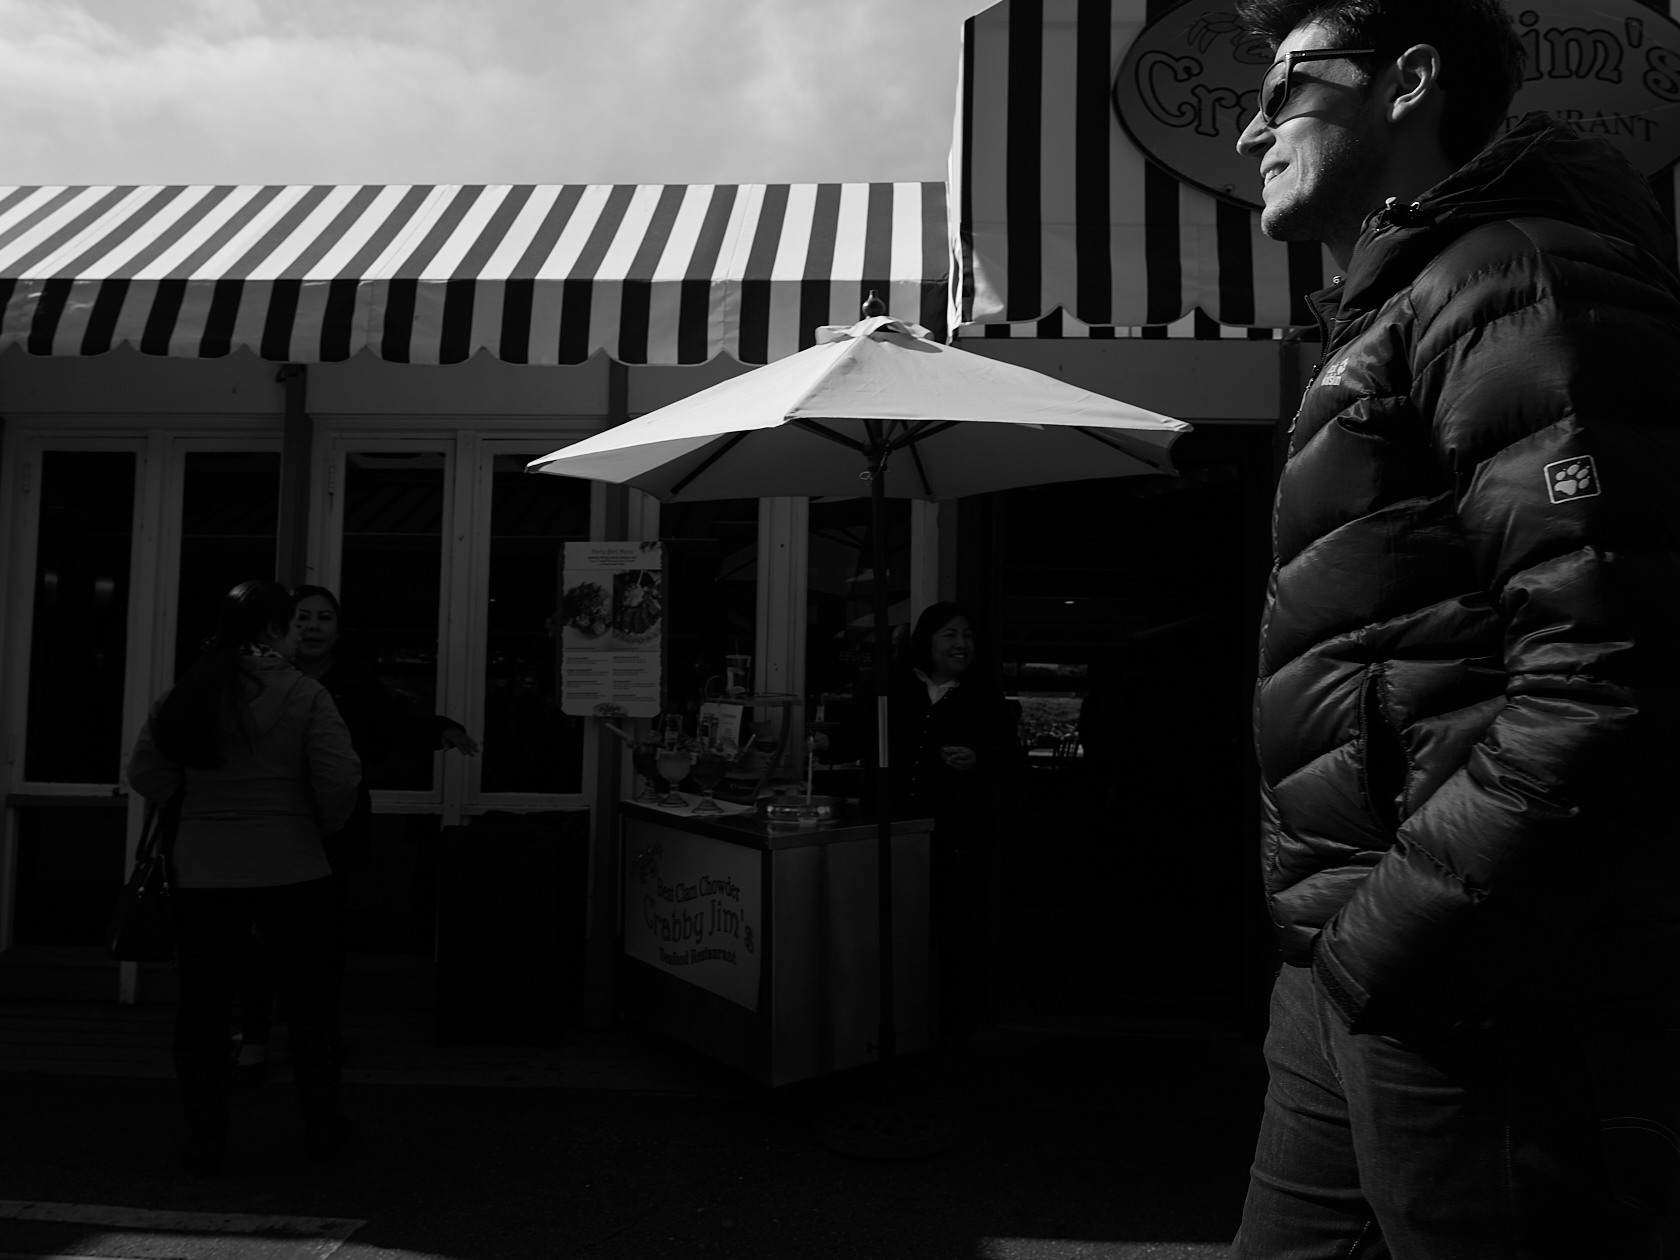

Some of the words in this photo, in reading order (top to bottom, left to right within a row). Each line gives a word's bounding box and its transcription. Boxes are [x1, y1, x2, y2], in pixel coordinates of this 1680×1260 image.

[657, 876, 674, 902] Best
[675, 882, 698, 903] Clam
[698, 875, 741, 902] Chowder
[643, 893, 704, 945] Crabby
[708, 899, 754, 954] Jim's
[659, 947, 689, 966] Seafood
[690, 947, 738, 966] Restaurant
